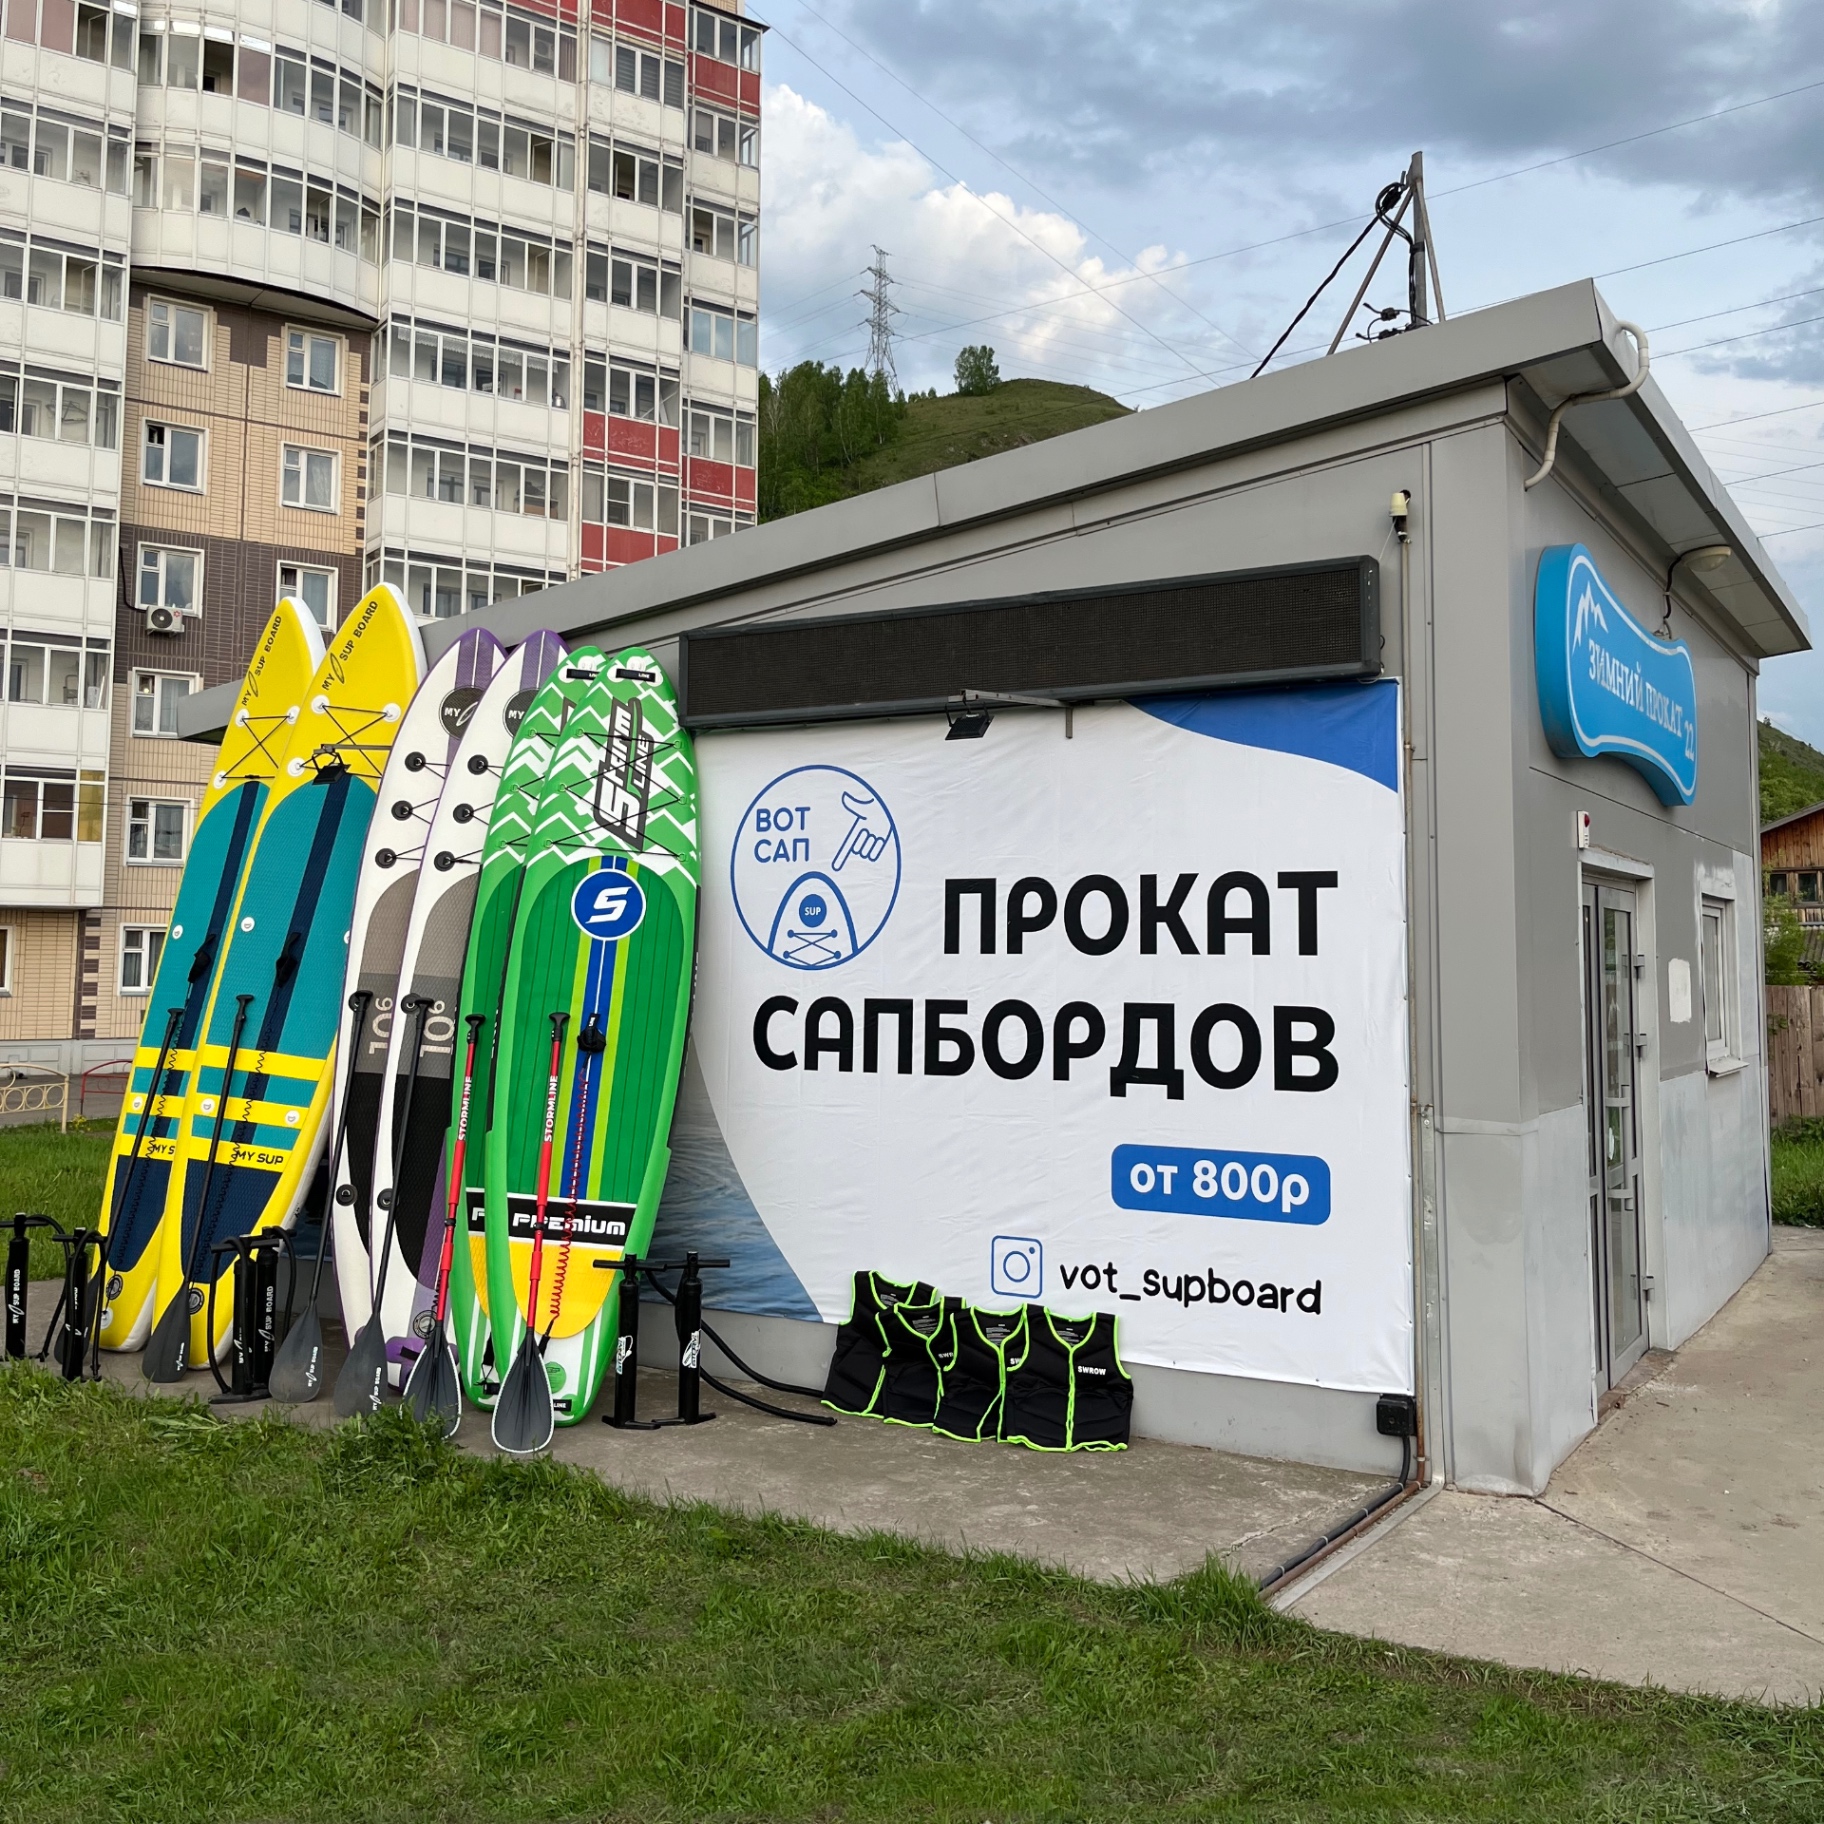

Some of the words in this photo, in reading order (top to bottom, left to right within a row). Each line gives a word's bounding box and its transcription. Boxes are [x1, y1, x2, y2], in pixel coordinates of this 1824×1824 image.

[242, 689, 252, 706] MY
[254, 655, 266, 677] SUP
[264, 615, 282, 653] BOARD
[322, 673, 336, 691] MY
[339, 639, 355, 661] SUP
[353, 600, 378, 639] BOARD
[1588, 637, 1644, 713] ЗИМНИЙ
[1645, 681, 1683, 738] ПРОКАТ
[444, 707, 462, 717] MY
[508, 709, 525, 720] MY
[631, 733, 649, 789] LINE
[756, 806, 811, 833] ВОТ
[754, 838, 810, 863] САП
[804, 906, 822, 916] SUP
[943, 870, 1339, 956] ПРОКАТ
[753, 995, 1339, 1101] САПБОРДОВ
[457, 1076, 473, 1141] STORMLINE
[544, 1075, 559, 1142] STORMLINE
[236, 1150, 255, 1161] MY
[256, 1153, 284, 1165] SUP
[1130, 1162, 1178, 1195] от
[1192, 1159, 1310, 1213] 800р
[13, 1268, 21, 1292] BOARD
[266, 1285, 274, 1313] BOARD
[1060, 1261, 1321, 1315] vot_supboard
[265, 1315, 273, 1330] SUP
[1077, 1365, 1107, 1376] SWROW
